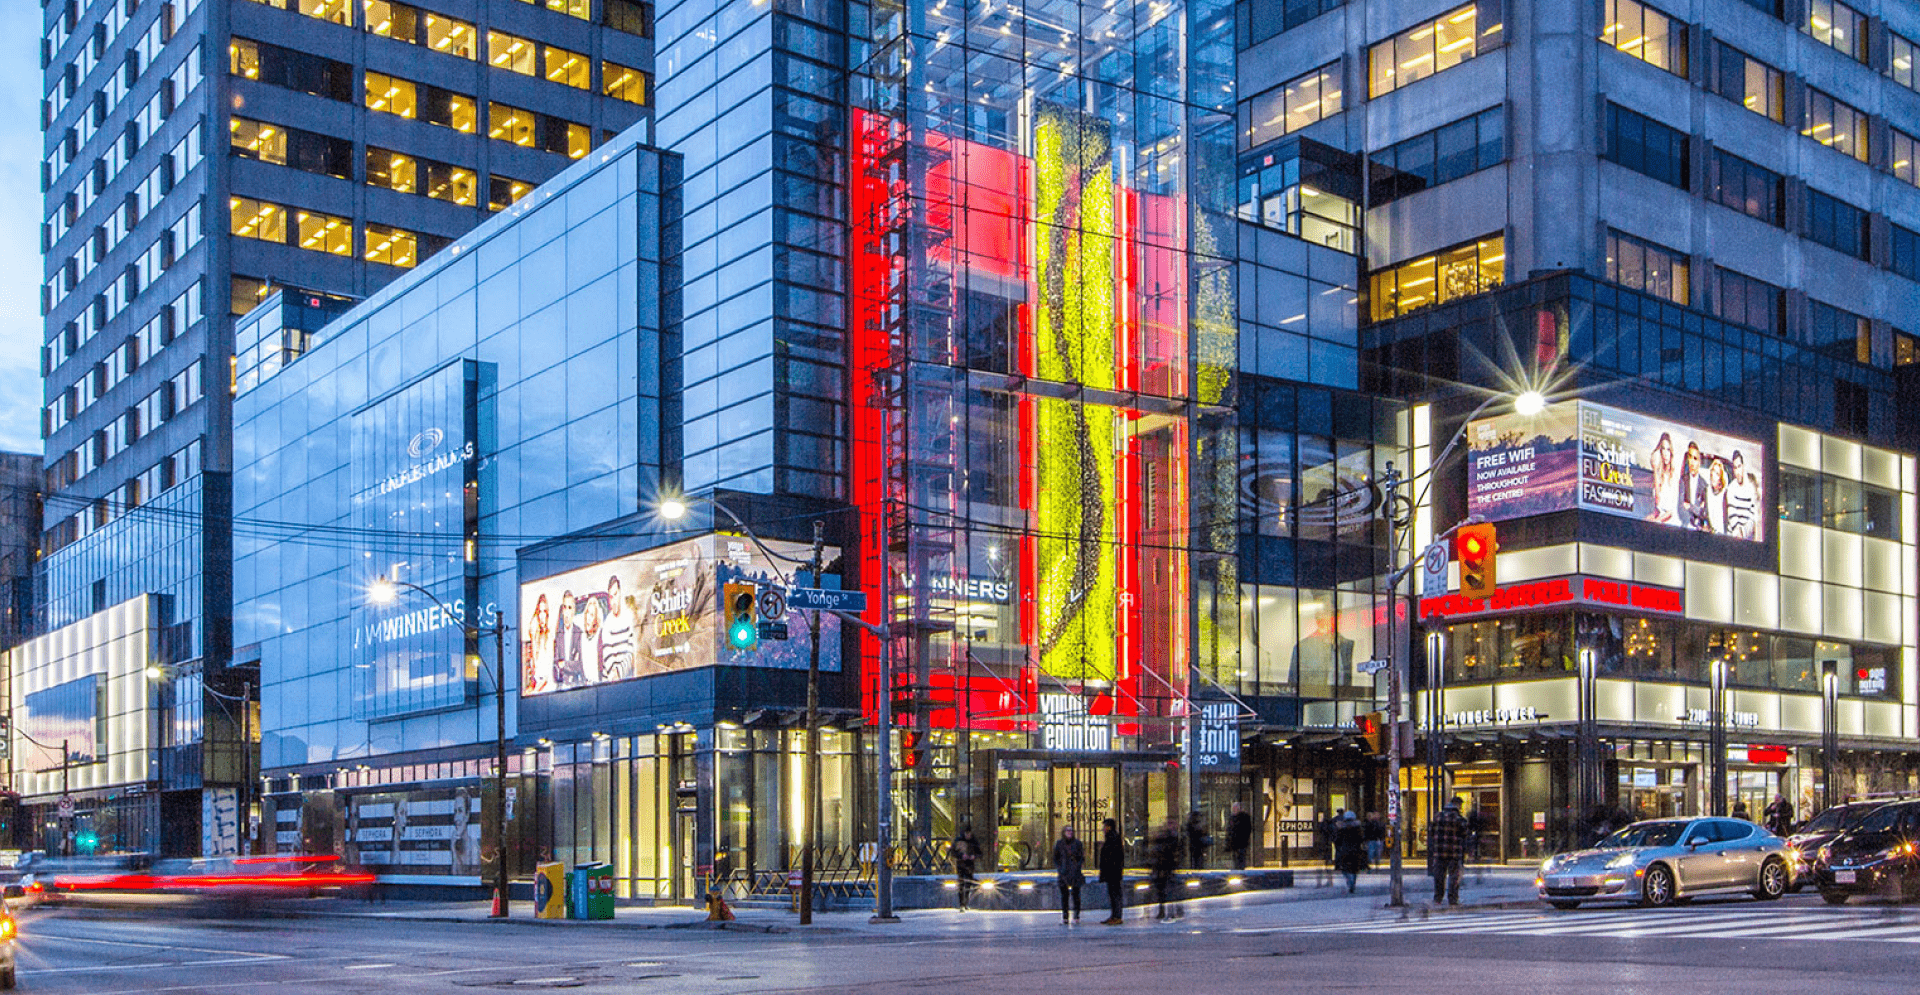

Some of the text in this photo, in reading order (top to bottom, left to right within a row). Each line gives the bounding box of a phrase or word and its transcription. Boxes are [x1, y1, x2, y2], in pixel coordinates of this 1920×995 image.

[1477, 447, 1535, 469] FREE WIFI
[1477, 462, 1536, 480] NOW AVAILABLE
[1477, 475, 1530, 492] THROUGHOUT
[1477, 494, 1491, 503] THE
[901, 573, 1008, 600] WNNERS
[1490, 579, 1574, 610] BARREL
[806, 591, 840, 608] Yonge
[384, 599, 465, 642] WINNERS
[655, 609, 691, 637] Creek
[1453, 710, 1490, 725] YONGE
[1495, 706, 1536, 722] TOWER
[361, 828, 386, 839] SEPHORA
[414, 827, 443, 838] SEPHORA
